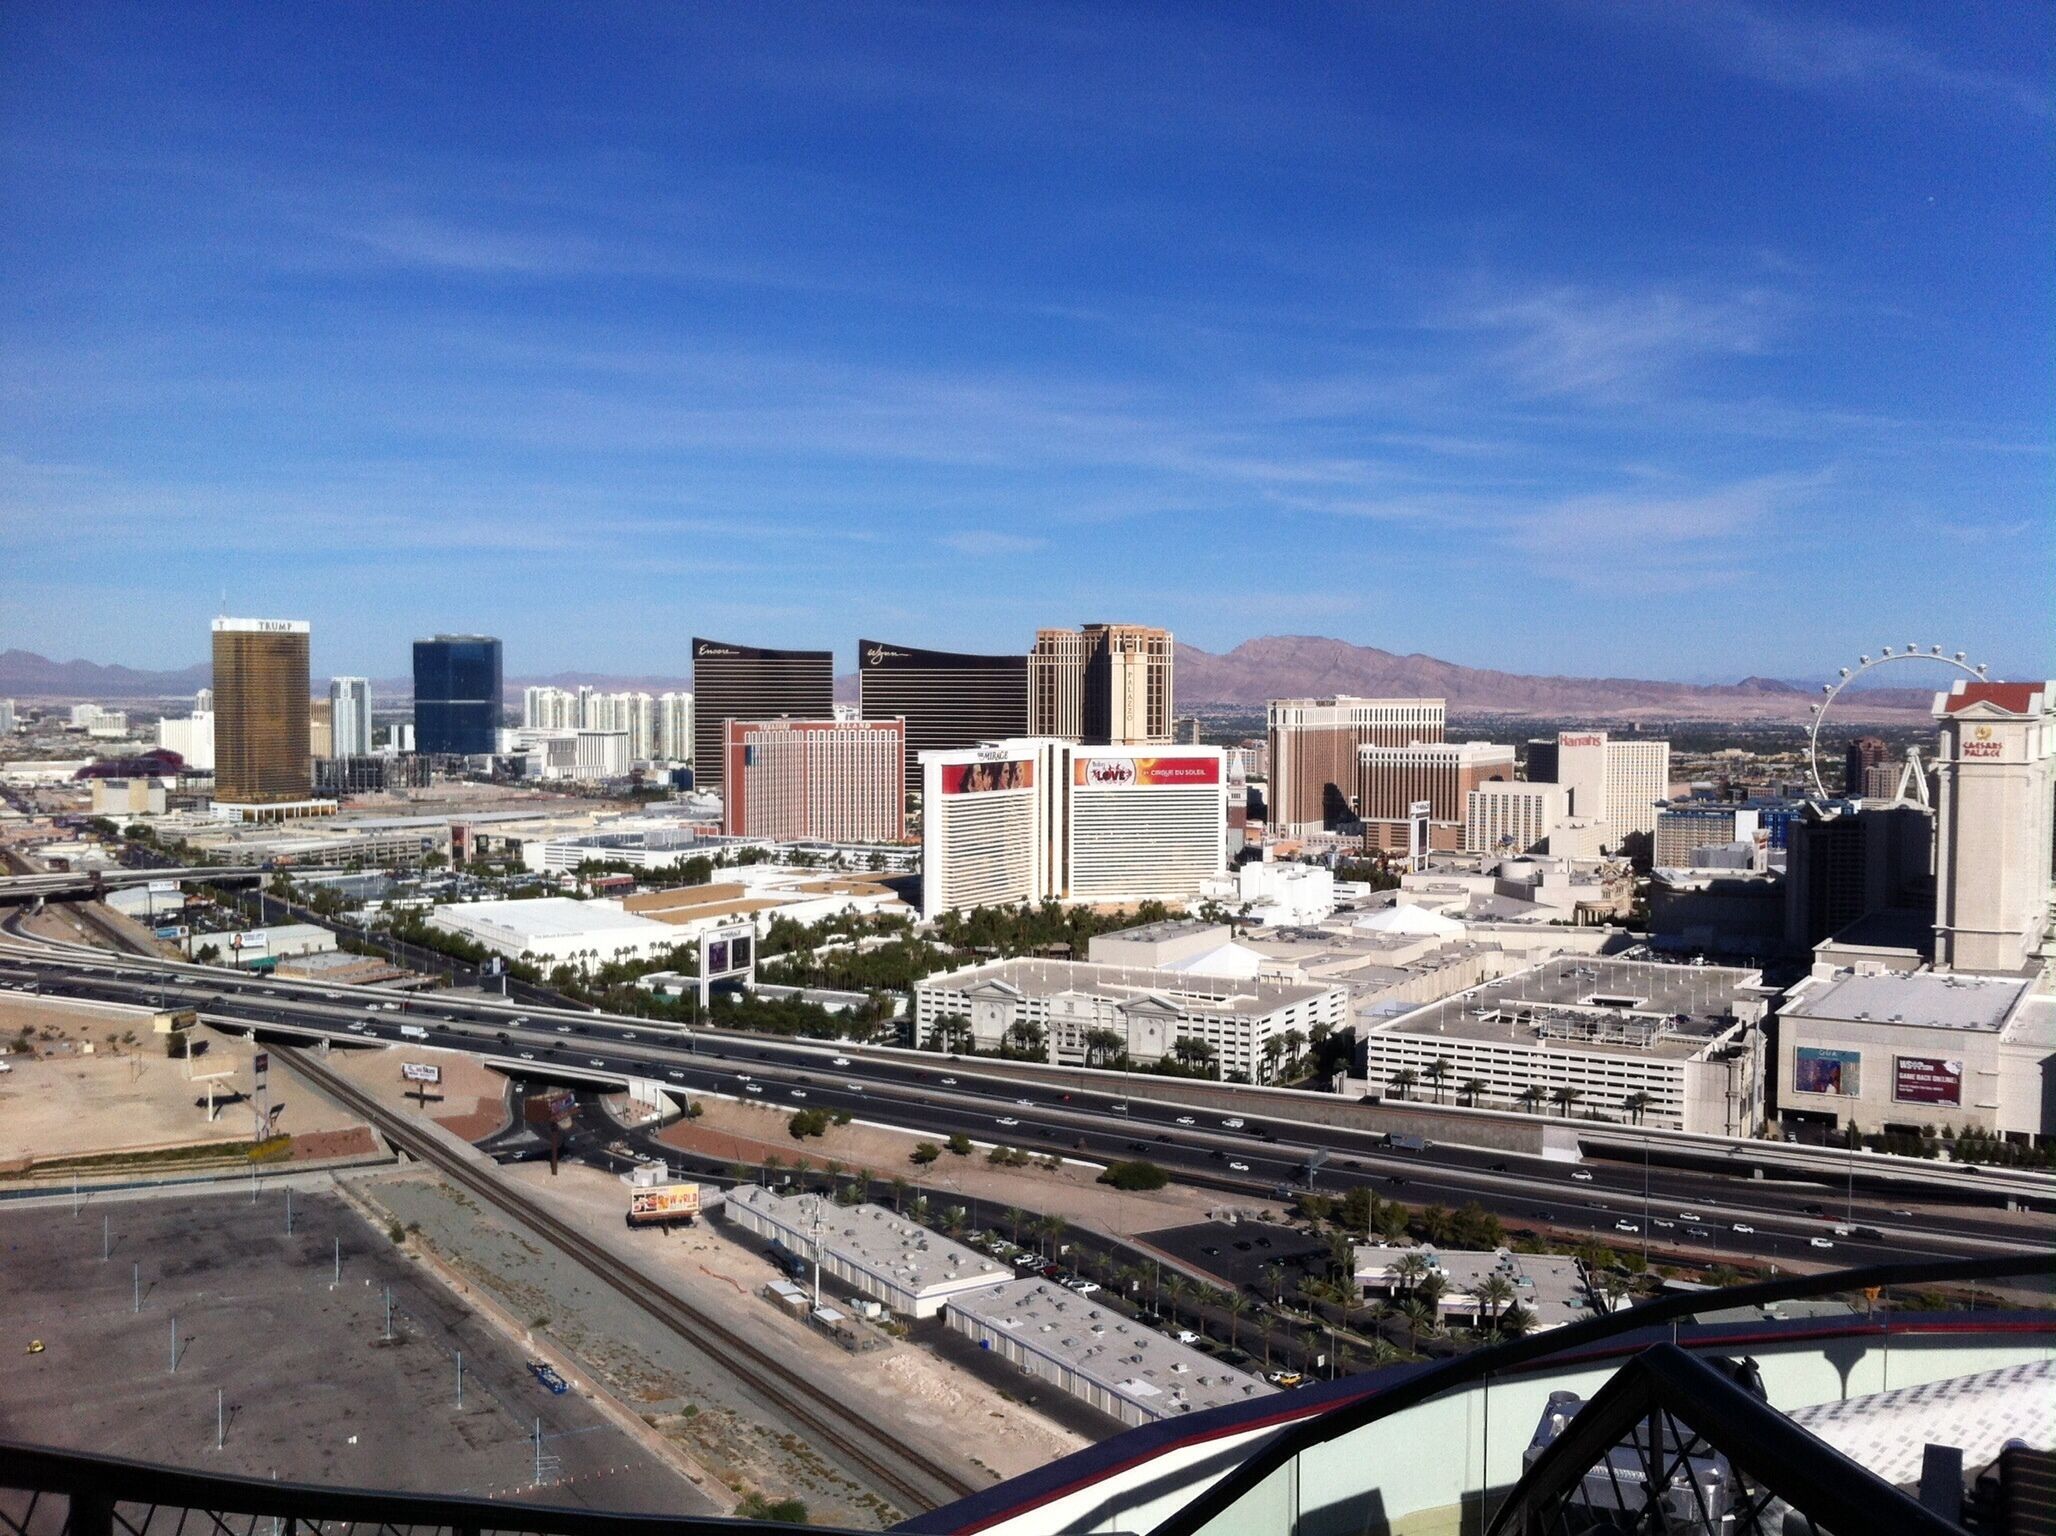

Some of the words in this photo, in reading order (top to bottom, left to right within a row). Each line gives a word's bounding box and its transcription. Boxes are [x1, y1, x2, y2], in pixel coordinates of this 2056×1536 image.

[258, 621, 293, 632] TRUMP
[698, 643, 740, 656] Encore
[834, 722, 872, 730] ISLAND
[1963, 741, 2003, 750] CAESARS
[983, 751, 1009, 761] MIRAGE
[1964, 749, 2000, 758] PALACE
[1096, 770, 1126, 781] LOVE
[1151, 769, 1174, 777] CIRQUE
